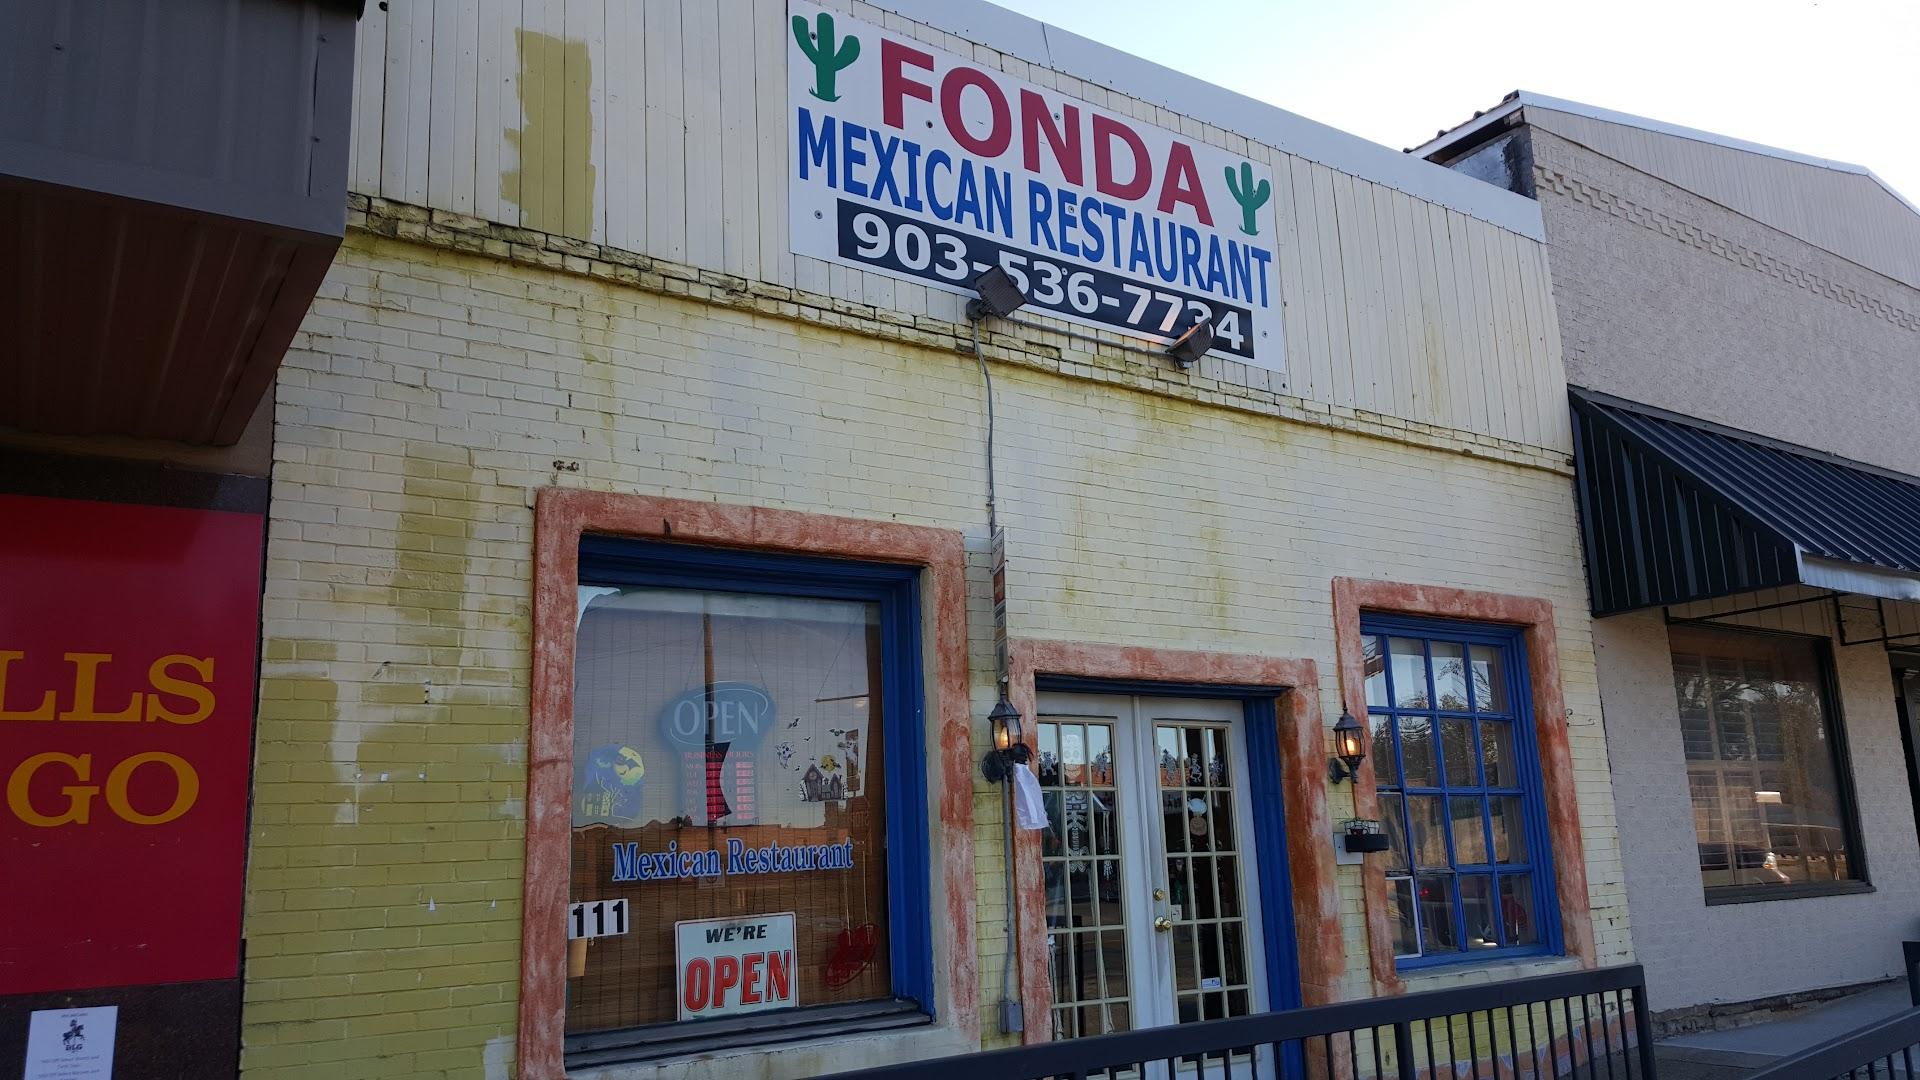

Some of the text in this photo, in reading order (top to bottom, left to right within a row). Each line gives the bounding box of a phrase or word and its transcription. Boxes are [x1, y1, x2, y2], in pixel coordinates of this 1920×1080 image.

[881, 38, 1214, 227] FONDA
[798, 107, 1272, 308] MEXICAN RESTAURANT
[674, 700, 759, 736] OPEN
[6, 752, 200, 827] GO
[612, 836, 855, 882] Mexican Restaurant
[573, 901, 624, 937] 111
[705, 924, 768, 943] WE'RE
[684, 949, 791, 1013] OPEN
